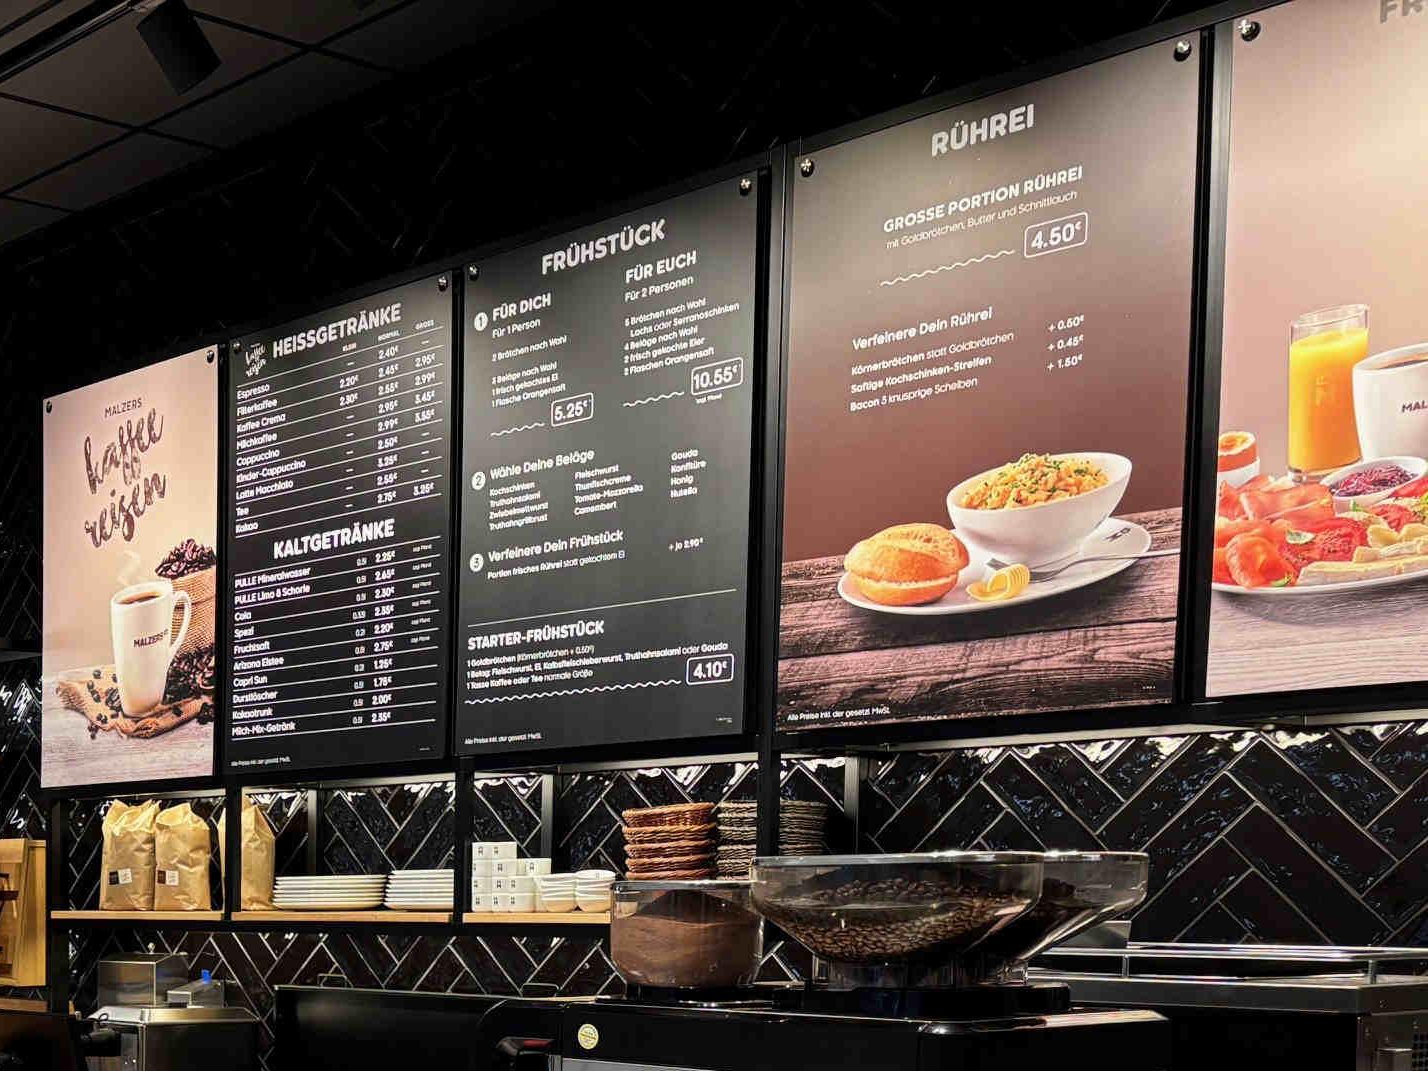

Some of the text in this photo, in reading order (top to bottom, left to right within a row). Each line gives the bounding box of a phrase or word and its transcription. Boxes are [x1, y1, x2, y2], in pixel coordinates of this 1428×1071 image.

[931, 103, 1035, 157] RÜHREI
[883, 165, 1083, 233] GROSSE PORTION RÜHREI
[967, 213, 996, 228] Butter
[997, 207, 1017, 220] und
[1019, 190, 1078, 215] Schnittlauch
[541, 218, 666, 275] FRÜHSTÜCK
[625, 250, 697, 284] FÜR EUCH
[625, 290, 640, 303] Für
[648, 275, 694, 296] Personen
[492, 292, 552, 322] FÜR DICH
[272, 302, 402, 359] HEISSGETRÄNKE
[492, 318, 541, 340] Für Person
[852, 306, 993, 350] Verfeinere Dein Rührei
[851, 353, 925, 376] Körnerbrötchen
[236, 383, 270, 401] Espresso
[104, 397, 143, 418] MALZERS
[236, 398, 278, 417] Filterkaffee
[850, 398, 880, 412] Bacon
[236, 416, 260, 433] Kaffee
[261, 412, 286, 428] Crema
[84, 408, 164, 494] kaffee
[236, 432, 278, 450] Milchkaffee
[236, 448, 280, 467] Cappuccino
[490, 450, 595, 481] Wähle Deine Beläge
[671, 448, 699, 462] Gouda
[236, 459, 306, 484] Kinder-Cappuccino
[84, 473, 166, 548] reisen
[236, 506, 249, 517] Tee
[235, 521, 259, 534] Kakao
[273, 518, 395, 560] KALTGETRÄNKE
[488, 529, 624, 563] Verfeinere Dein Frühstück
[234, 566, 311, 589] PULLE Mineralwasser
[234, 591, 257, 606] PULLE
[281, 582, 311, 598] Schorle
[234, 610, 252, 621] Cola
[234, 625, 255, 639] Spezi
[467, 620, 605, 651] STARTER-FRÜHSTÜCK
[233, 640, 271, 655] Fruchtsaft
[233, 657, 262, 672] Arizona
[233, 674, 268, 688] Capri Sun
[232, 690, 278, 705] Durstlöscher
[232, 706, 273, 720] Kakaotrunk
[231, 720, 296, 737] Milch-Mix-Getränk
